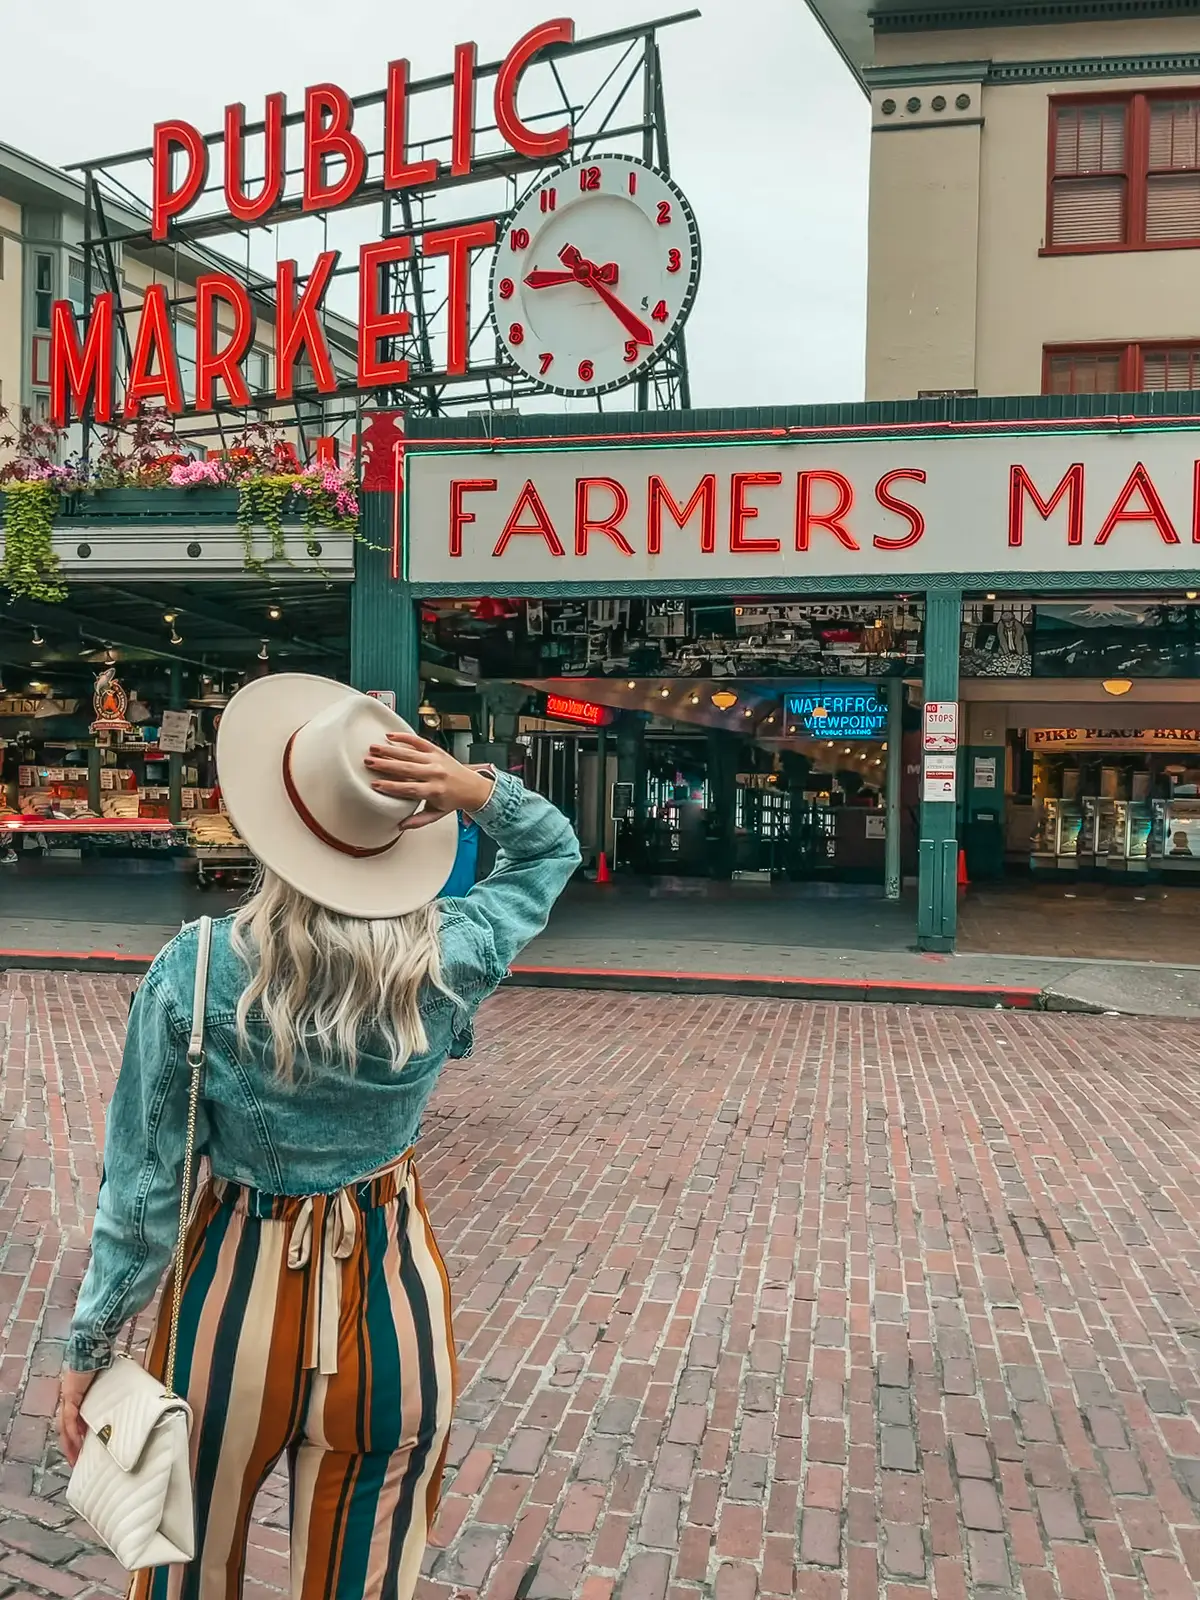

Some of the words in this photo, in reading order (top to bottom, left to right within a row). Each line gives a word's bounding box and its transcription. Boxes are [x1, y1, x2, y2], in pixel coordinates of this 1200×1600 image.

[152, 18, 575, 240] PUBLIC
[580, 167, 600, 191] 12
[629, 172, 636, 195] 1
[540, 188, 556, 212] 11
[657, 201, 671, 225] 2
[510, 228, 529, 251] 10
[667, 248, 681, 272] 3
[500, 278, 514, 299] 9
[651, 300, 669, 322] 4
[51, 220, 497, 427] MARKET
[509, 323, 523, 345] 8
[624, 341, 638, 363] 5
[539, 353, 554, 374] 7
[578, 360, 593, 381] 6
[448, 468, 927, 557] FARMERS
[1008, 459, 1200, 547] MA
[547, 698, 568, 712] OUND
[804, 716, 885, 728] VIEWPOINT
[1034, 728, 1078, 743] PIKE
[1085, 728, 1145, 739] PLACE
